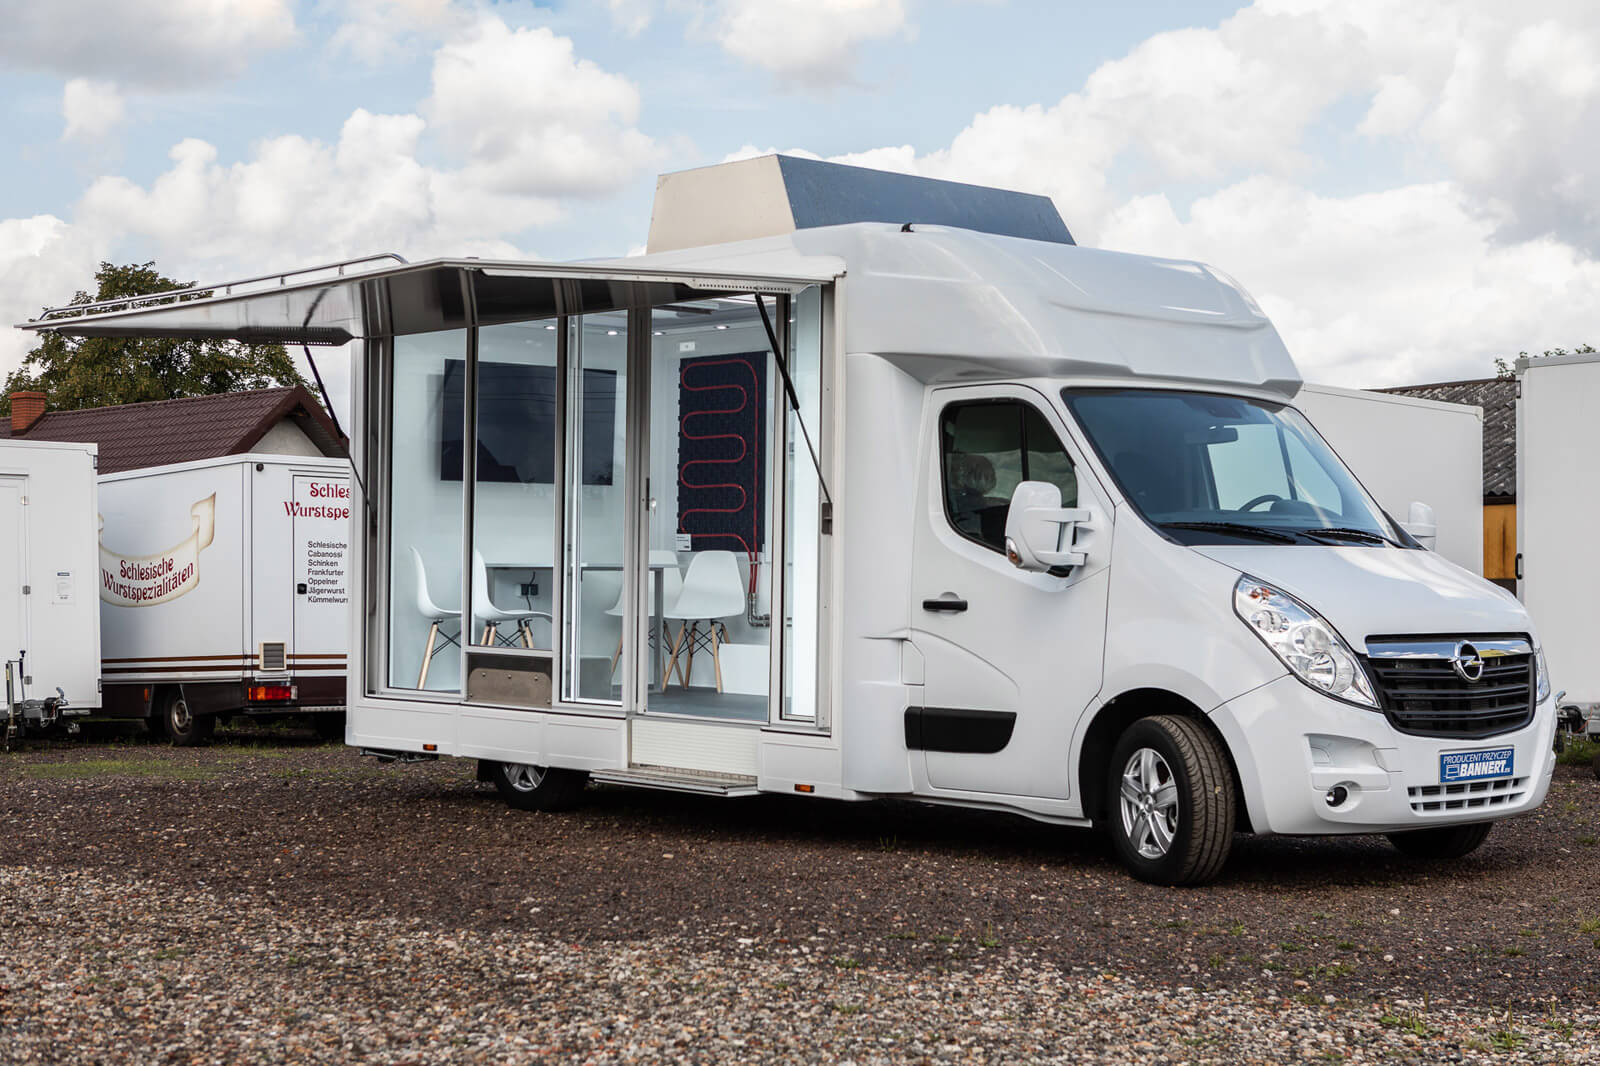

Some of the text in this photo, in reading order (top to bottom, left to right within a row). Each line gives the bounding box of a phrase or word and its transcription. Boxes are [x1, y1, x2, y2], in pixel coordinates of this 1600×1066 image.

[308, 541, 347, 549] Schlesische
[308, 550, 343, 558] Cabanossi
[120, 557, 174, 580] Schlesische
[308, 568, 344, 576] Frankfurter
[102, 562, 194, 603] Wurstspezialitäten
[308, 577, 338, 586] Oppelner
[308, 586, 345, 595] Jägerwurst
[1443, 751, 1511, 764] PRODUCENT PRZYCZEP
